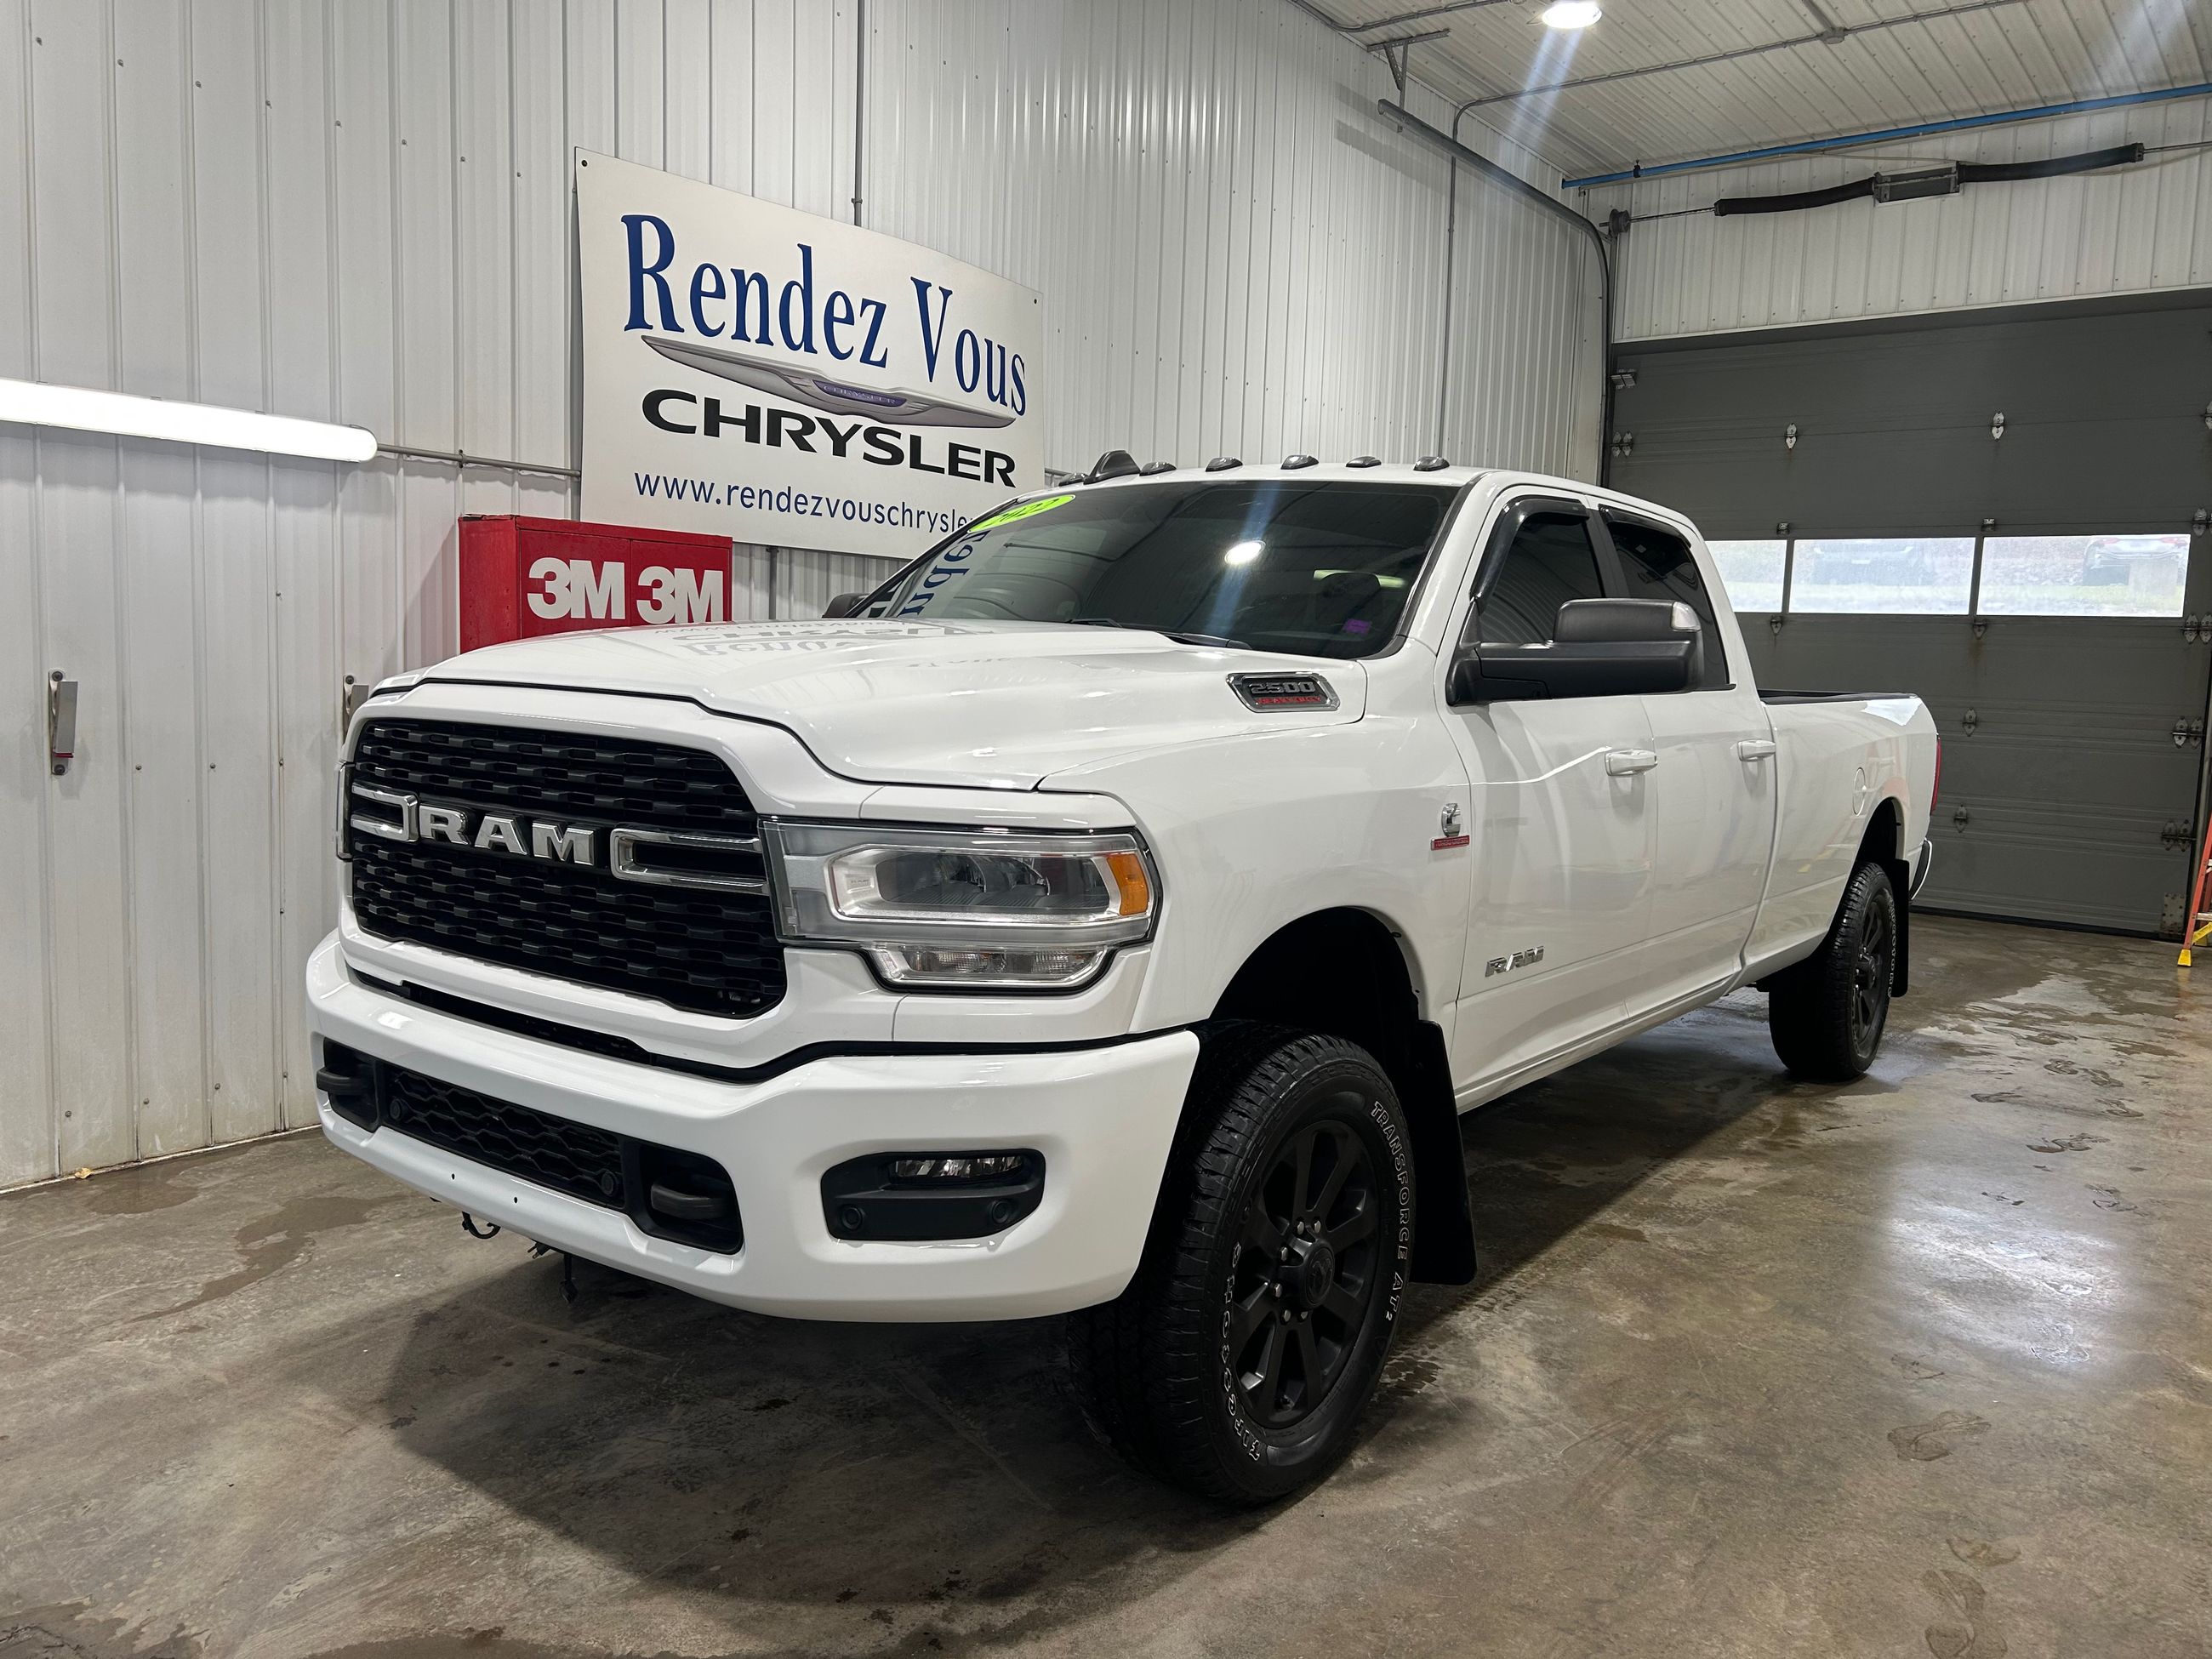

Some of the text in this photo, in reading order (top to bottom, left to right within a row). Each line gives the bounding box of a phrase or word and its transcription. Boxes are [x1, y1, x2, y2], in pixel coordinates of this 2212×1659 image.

[620, 214, 1026, 417] Rendez Vous
[641, 388, 1016, 487] CHRYSLER
[634, 472, 972, 533] www.rendezvouschrysle
[527, 557, 625, 620] 3M
[636, 566, 723, 624] 3M
[1249, 682, 1316, 694] 2500
[419, 805, 595, 866] RAM
[1485, 945, 1544, 978] RAM
[1371, 1102, 1410, 1261] TRANSFORCE
